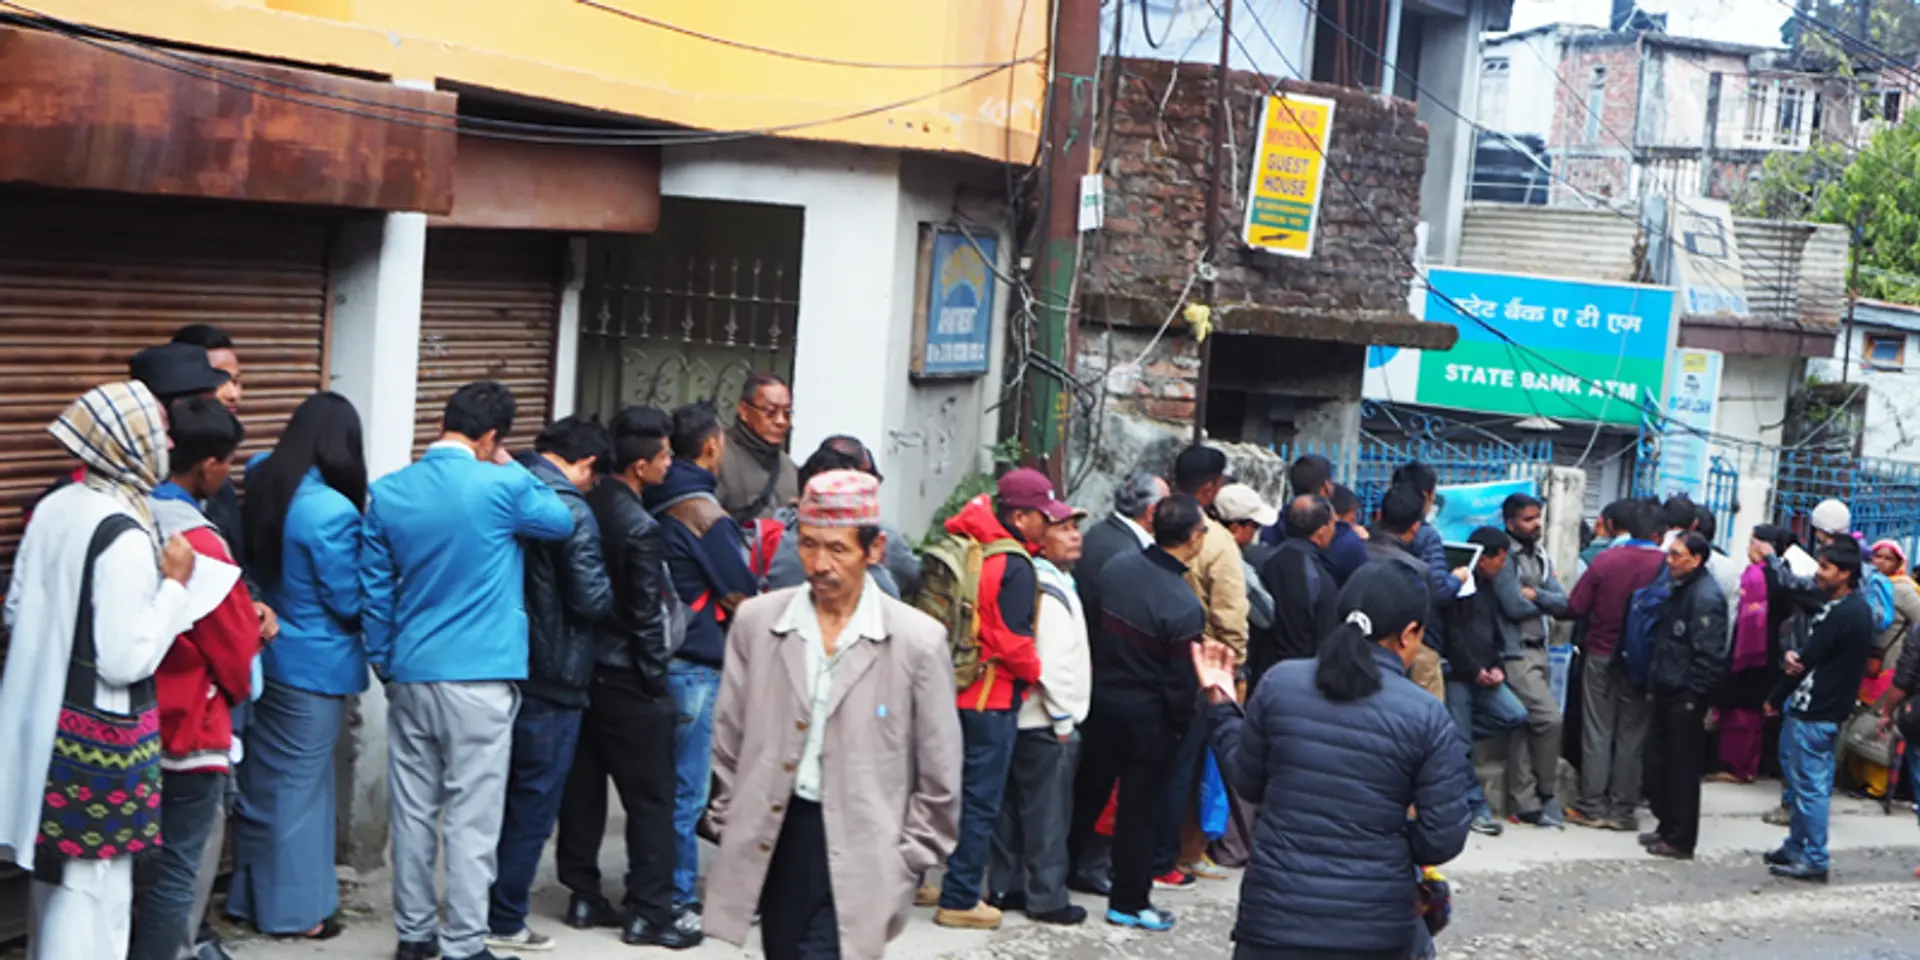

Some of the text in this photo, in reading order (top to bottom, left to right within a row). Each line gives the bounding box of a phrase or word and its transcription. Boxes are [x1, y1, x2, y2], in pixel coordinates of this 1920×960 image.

[1267, 154, 1310, 175] GUEST
[1263, 176, 1308, 197] HOUSE
[1553, 306, 1569, 328] ए
[1576, 304, 1600, 331] टी
[1608, 313, 1643, 334] एम
[1445, 363, 1638, 401] STATE BANK ATM
